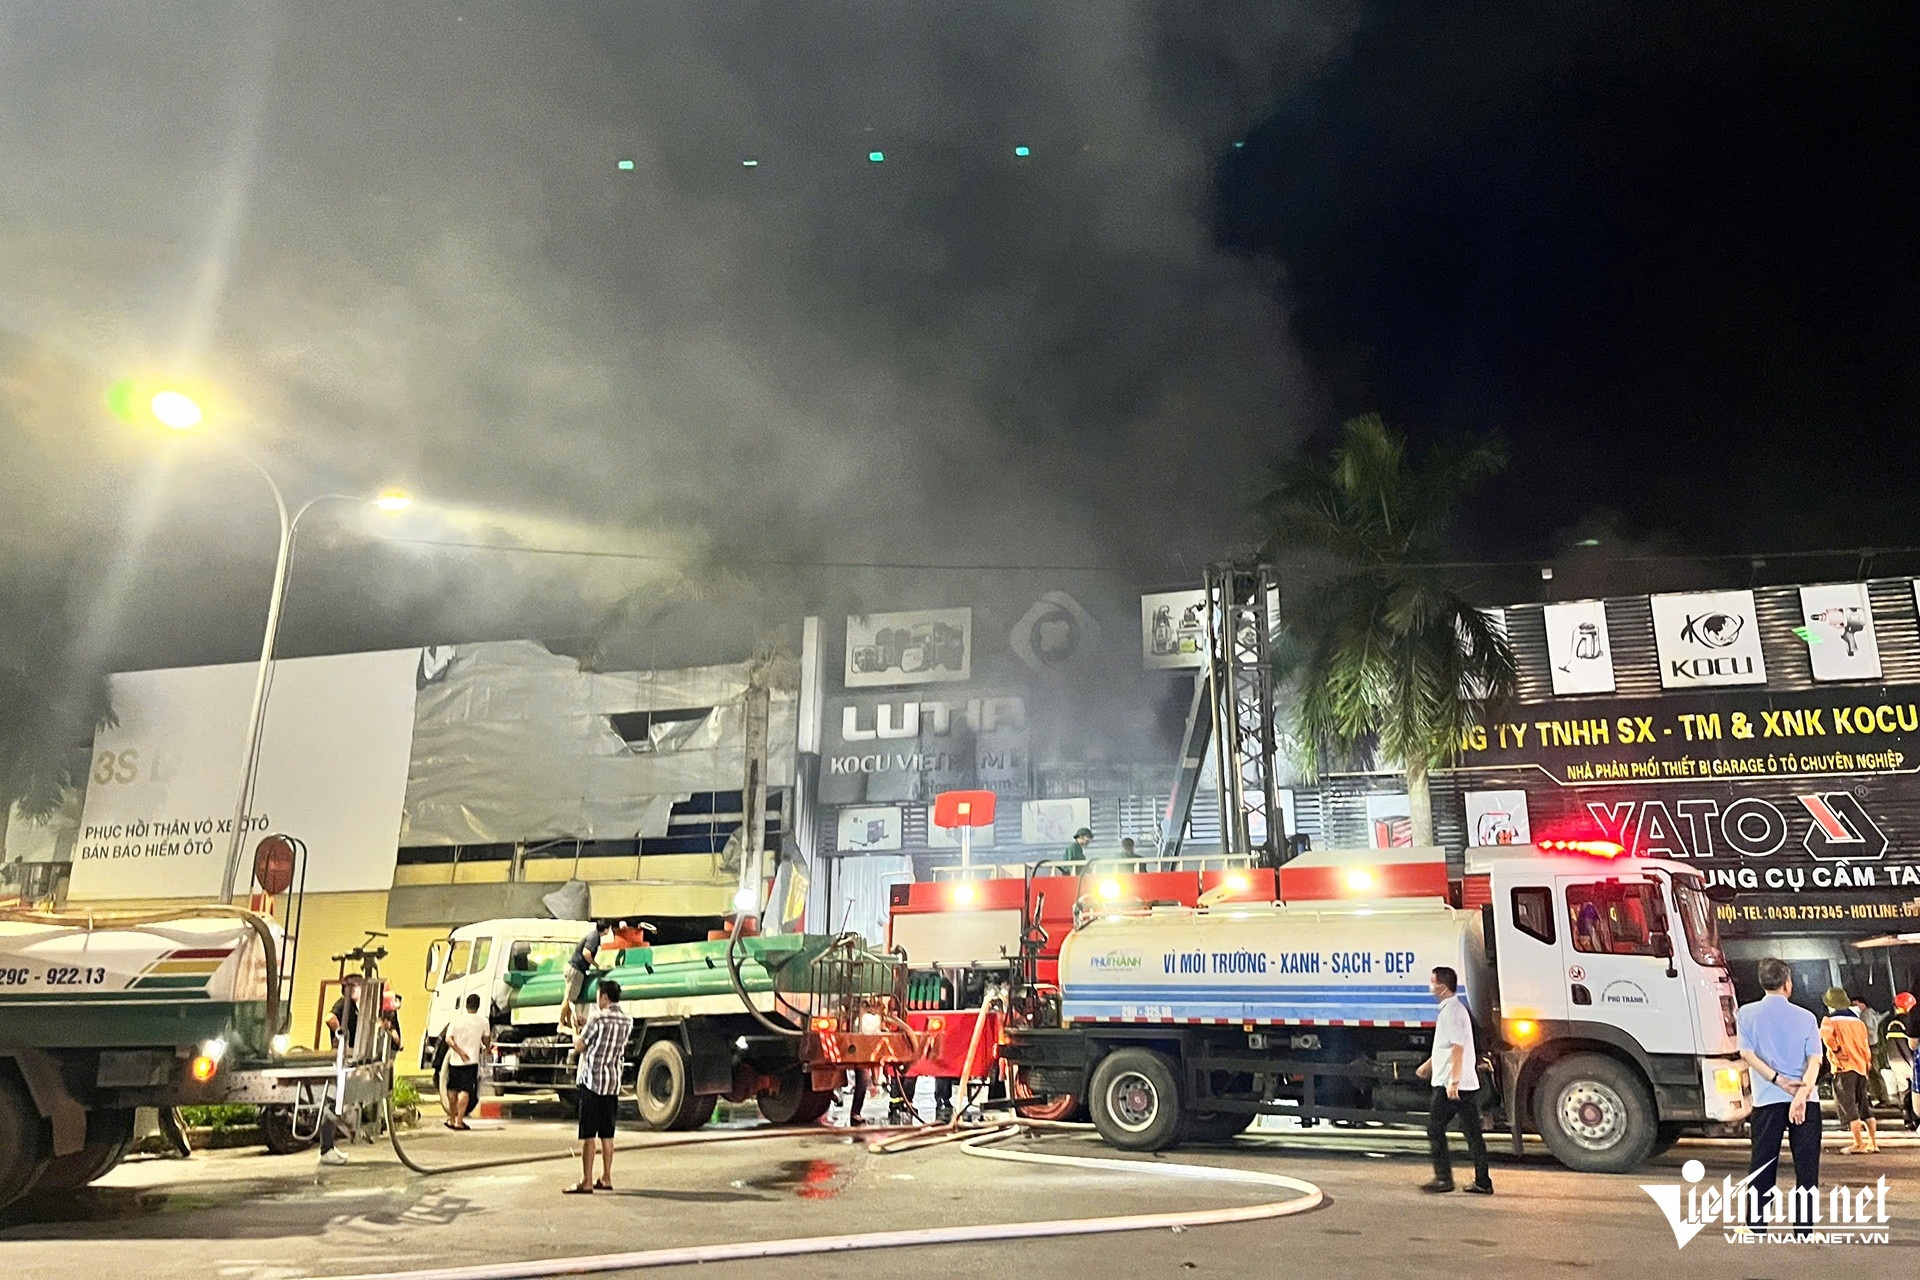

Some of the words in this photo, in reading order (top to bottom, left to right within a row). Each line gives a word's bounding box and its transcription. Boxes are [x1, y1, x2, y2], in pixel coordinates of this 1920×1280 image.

[1671, 657, 1753, 679] KOCU
[1493, 722, 1527, 749] TY
[1535, 718, 1610, 747] TNHH
[1617, 716, 1657, 744] SX
[1678, 713, 1722, 741] TM
[1731, 712, 1755, 740] &
[1761, 709, 1826, 738] XNK
[1833, 704, 1919, 734] KOCU
[830, 754, 892, 775] KOCU
[1567, 761, 1594, 780] NHÀ
[1595, 760, 1629, 779] PHÂN
[1631, 755, 1660, 778] PHỐI
[1662, 755, 1695, 776] THIẾT
[1713, 758, 1765, 775] GARAGE
[1768, 753, 1778, 772] Ô
[1780, 753, 1798, 771] TÔ
[1801, 751, 1853, 771] CHUYÊN
[1856, 749, 1904, 772] NGHIỆP
[85, 825, 122, 841] PHỤC
[1587, 798, 1788, 857] YATO
[1764, 868, 1805, 892] CỤ
[1812, 860, 1875, 887] CẦM
[47, 967, 106, 985] 922.13
[1164, 949, 1176, 974] VÌ
[1180, 949, 1206, 974] MÔI
[1212, 947, 1266, 974] TRƯỜNG
[1280, 952, 1320, 974] XANH
[1332, 952, 1371, 979] SẠCH
[1384, 952, 1415, 979] ĐẸP
